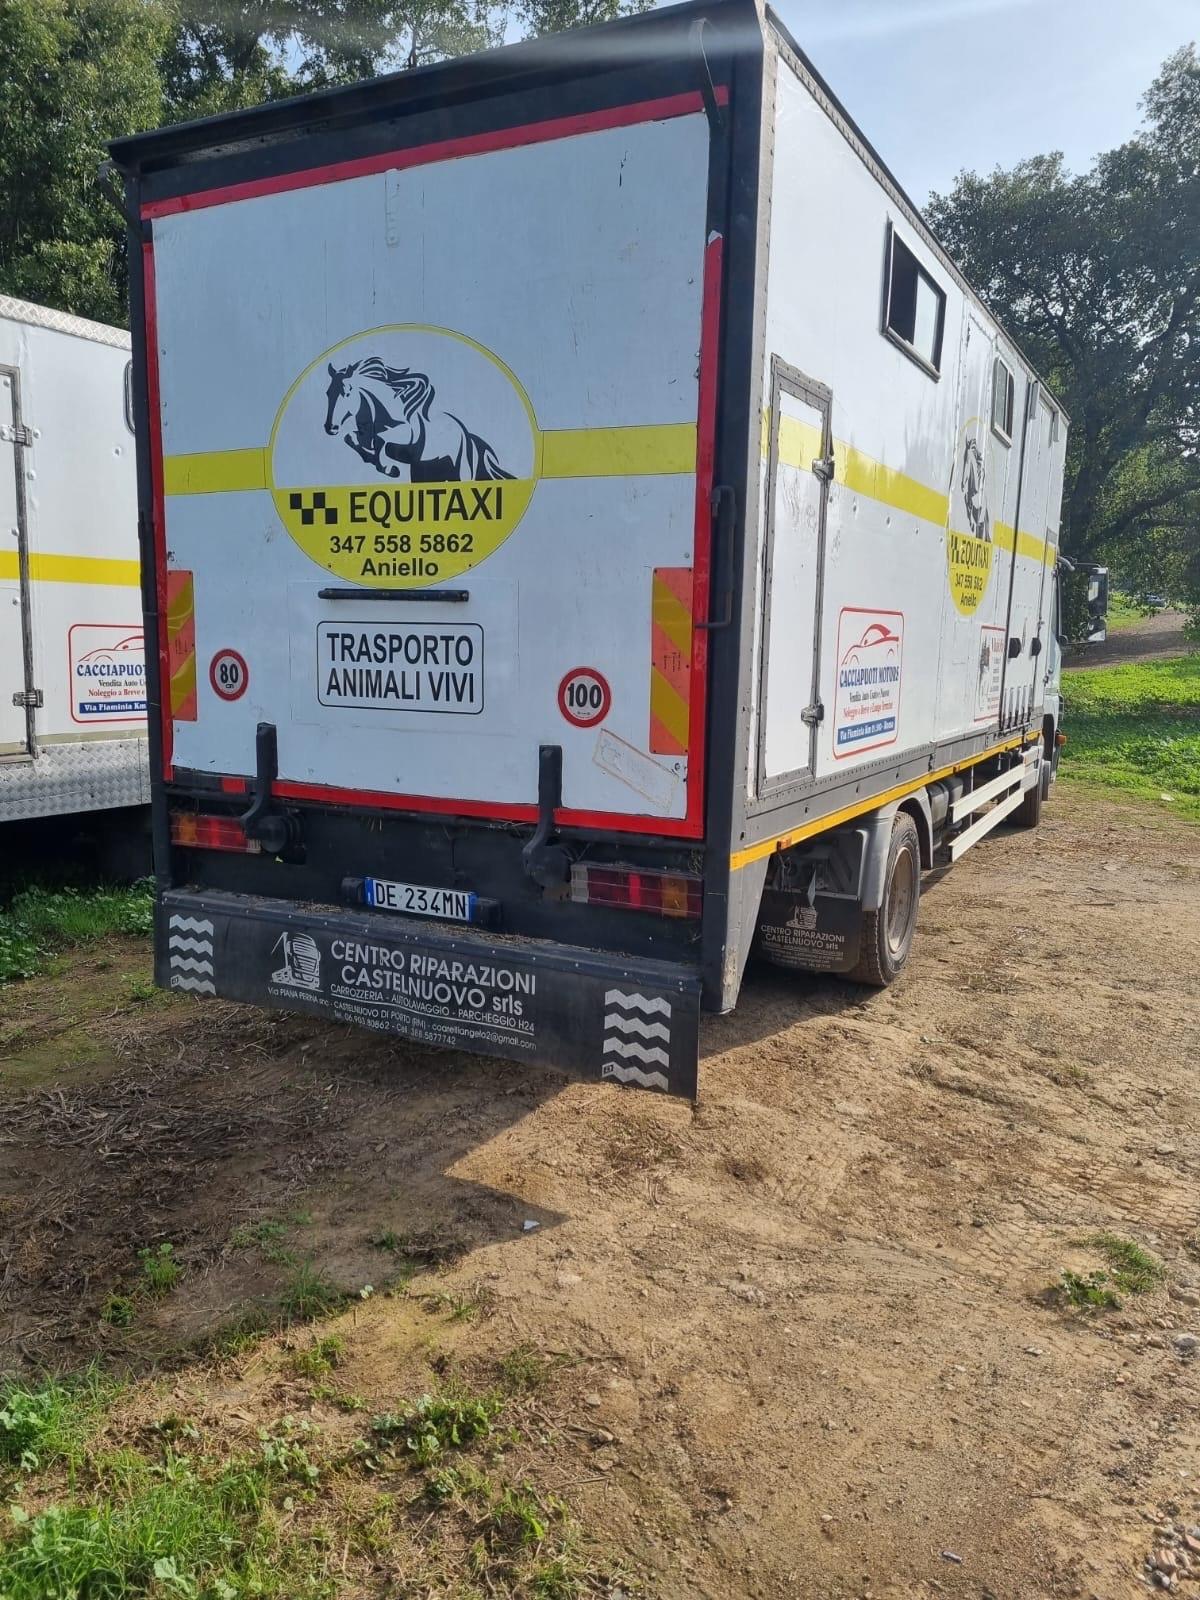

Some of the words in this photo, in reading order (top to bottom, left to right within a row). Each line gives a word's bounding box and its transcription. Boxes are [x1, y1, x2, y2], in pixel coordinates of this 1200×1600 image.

[350, 487, 503, 528] EQUITAXI
[330, 536, 365, 553] 347
[373, 535, 412, 553] 558
[419, 534, 474, 553] 5862
[361, 557, 439, 577] Aniello
[326, 632, 473, 667] TRASPORTO
[220, 663, 239, 684] 80
[326, 667, 421, 701] ANIMALI
[428, 671, 474, 704] VIVI
[84, 704, 97, 712] Via
[98, 703, 133, 711] Flaminia
[568, 682, 602, 709] 100
[375, 882, 397, 907] DE
[405, 888, 467, 918] 234MN
[760, 924, 792, 936] CENTRO
[793, 929, 845, 943] RIPARAZIONI
[765, 934, 824, 948] CASTELNUOVO
[331, 940, 405, 969] CENTRO
[410, 954, 536, 995] RIPARAZIONI
[341, 965, 486, 1008] CASTELNUOVO
[492, 994, 523, 1016] srls
[330, 983, 384, 1001] CARROZZERIA
[391, 994, 450, 1016] AUTOLAVAGGIO
[458, 1009, 517, 1028] PARCHEGGIO
[518, 1020, 534, 1032] H24
[334, 1001, 379, 1017] CASTELNUOVO
[381, 1009, 389, 1019] DI
[390, 1010, 411, 1024] PORTO
